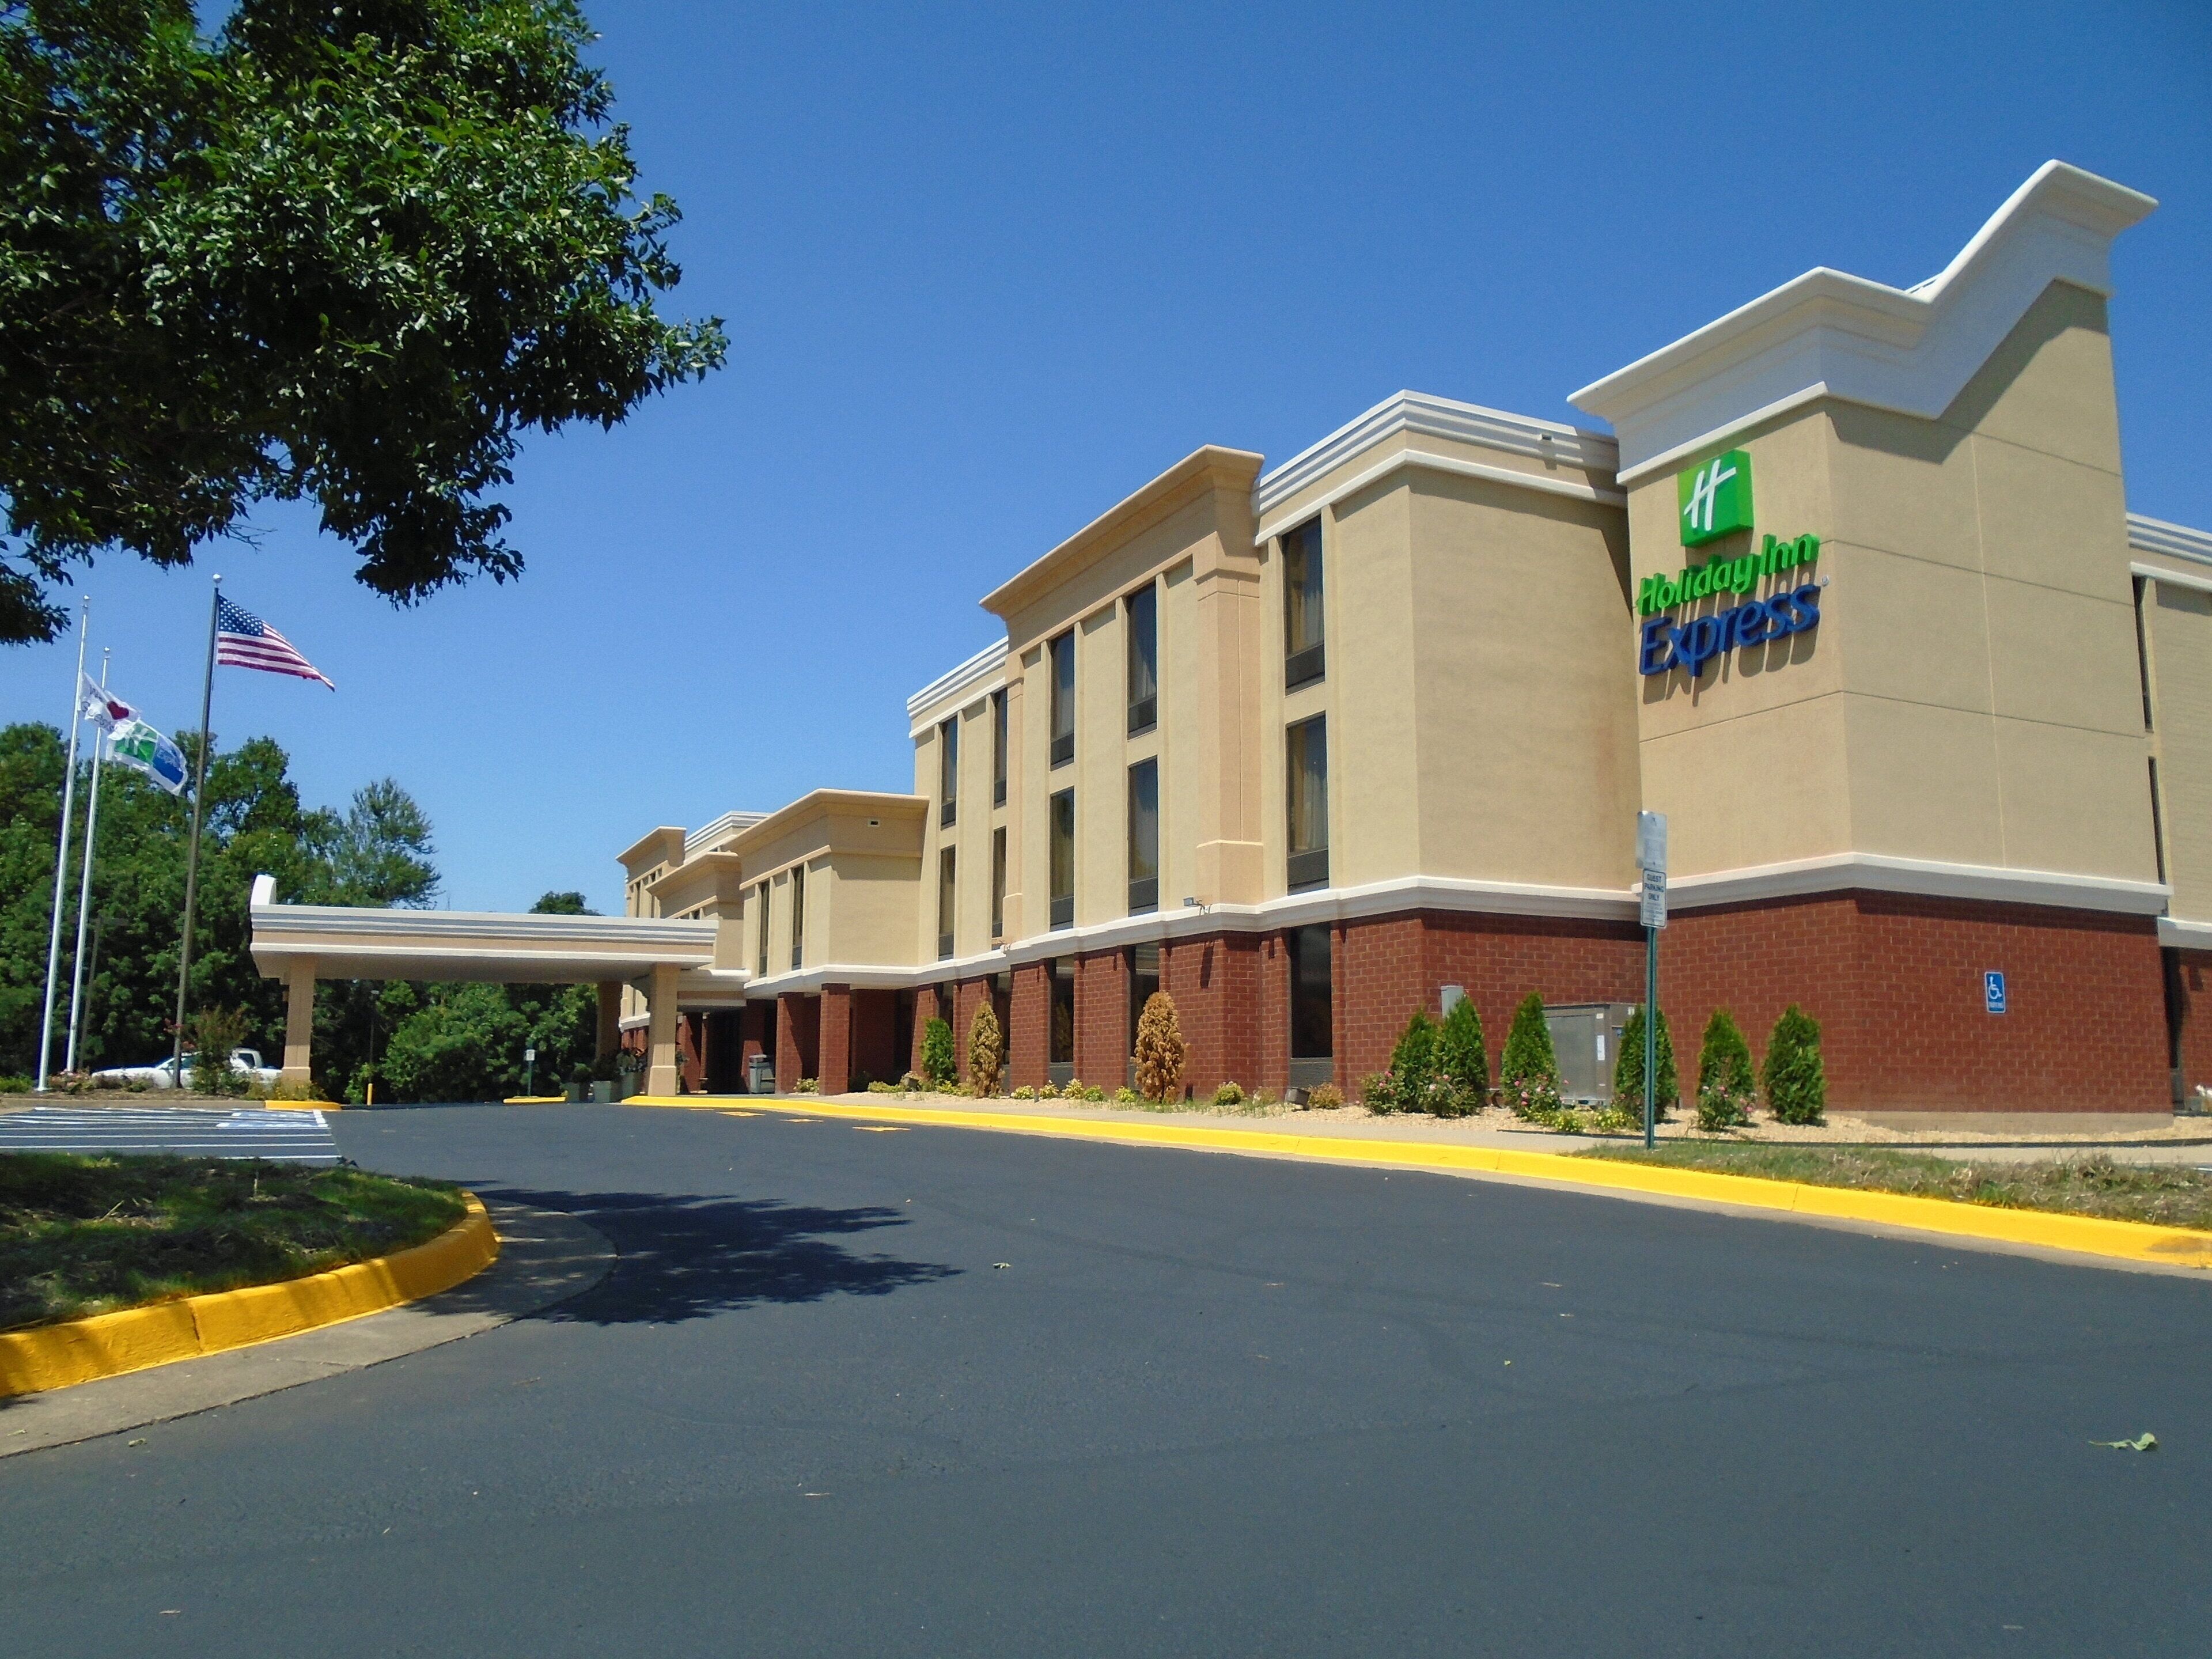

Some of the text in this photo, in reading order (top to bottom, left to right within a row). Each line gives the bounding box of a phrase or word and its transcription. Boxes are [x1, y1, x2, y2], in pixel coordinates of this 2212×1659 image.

[1683, 459, 1736, 531] H
[1636, 533, 1820, 616] Holiday Inn
[1639, 584, 1821, 677] Express
[1645, 882, 1664, 893] PARKING
[1647, 874, 1661, 882] GUEST
[1649, 893, 1660, 902] ONLY
